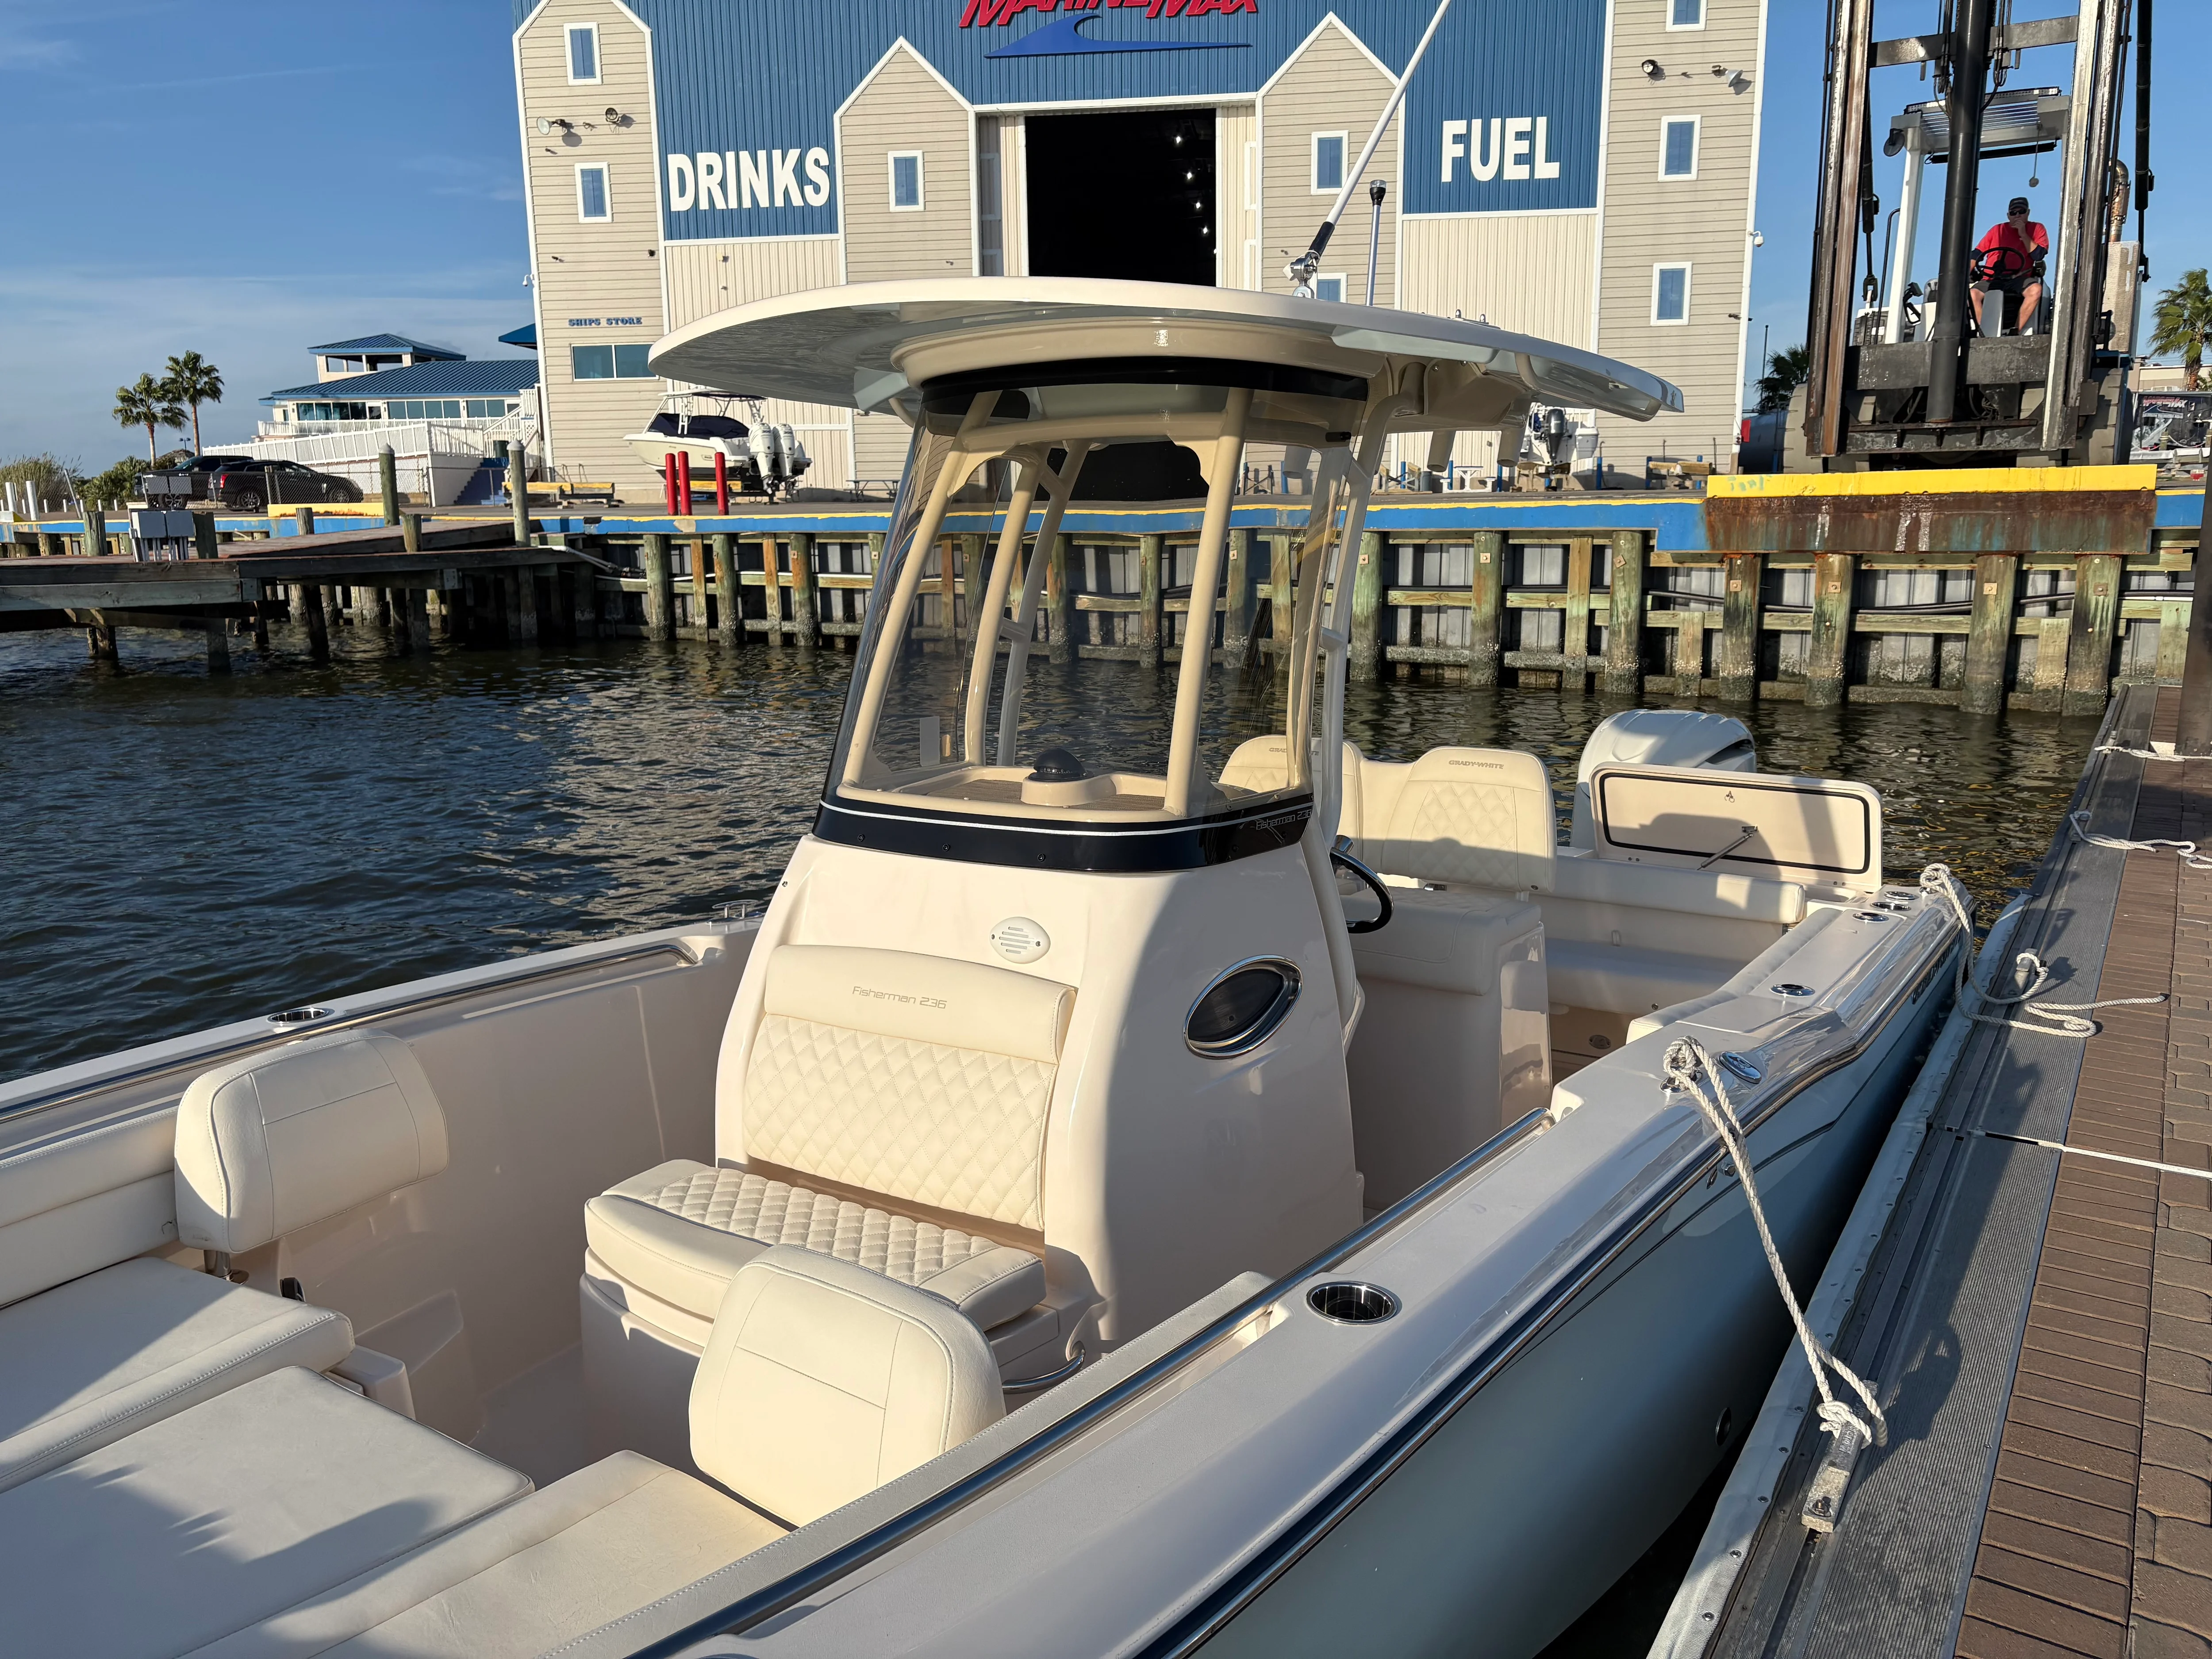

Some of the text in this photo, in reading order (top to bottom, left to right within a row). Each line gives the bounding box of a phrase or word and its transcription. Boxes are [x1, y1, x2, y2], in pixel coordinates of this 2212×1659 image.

[1441, 116, 1560, 182] FUEL
[667, 147, 830, 211] DRINKS
[606, 317, 642, 325] STORE
[1448, 760, 1504, 769] GRADY-WHITE
[852, 986, 947, 1009] Fisherman 236
